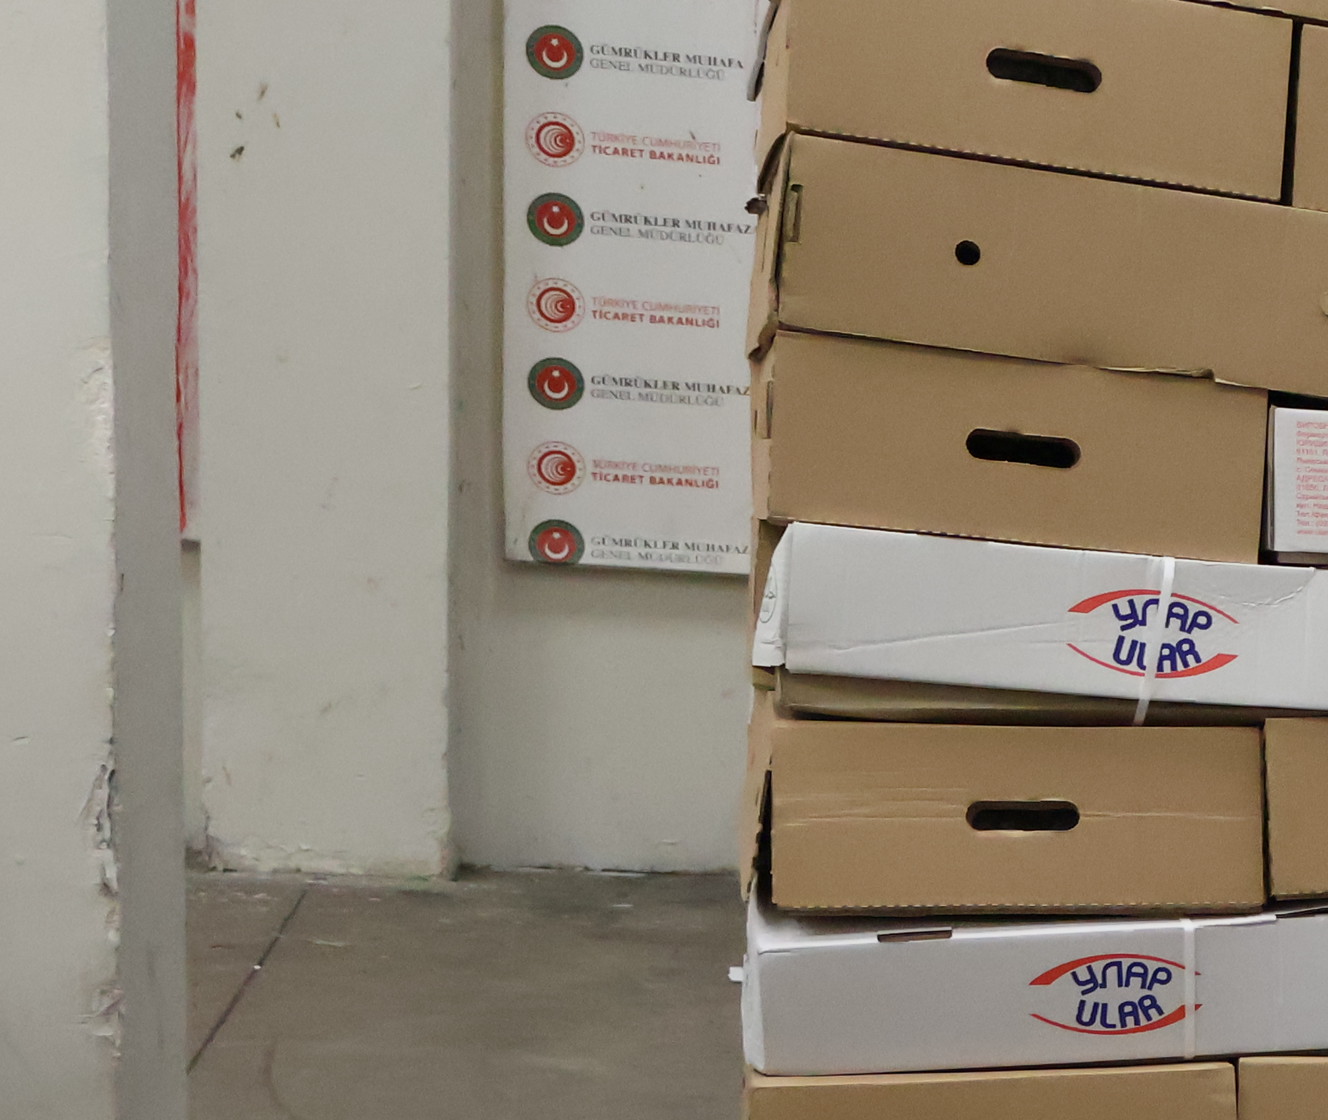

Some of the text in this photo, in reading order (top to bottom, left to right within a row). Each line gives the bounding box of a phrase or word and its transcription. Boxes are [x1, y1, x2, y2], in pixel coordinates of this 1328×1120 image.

[590, 43, 681, 63] GÜMRÜKLER
[590, 58, 632, 72] GENEL
[649, 149, 720, 165] BAKANLIĞI
[590, 210, 681, 229] GÜMRÜKLER
[590, 225, 631, 237] GENEL
[649, 314, 720, 329] BAKANLIĞI
[591, 374, 680, 391] GÜMRÜKLER
[591, 389, 634, 401] GENEL
[649, 475, 720, 489] BAKANLIĞI
[1113, 635, 1202, 673] ULAR
[1071, 961, 1173, 996] УЛАР
[1075, 994, 1165, 1029] ULAR
